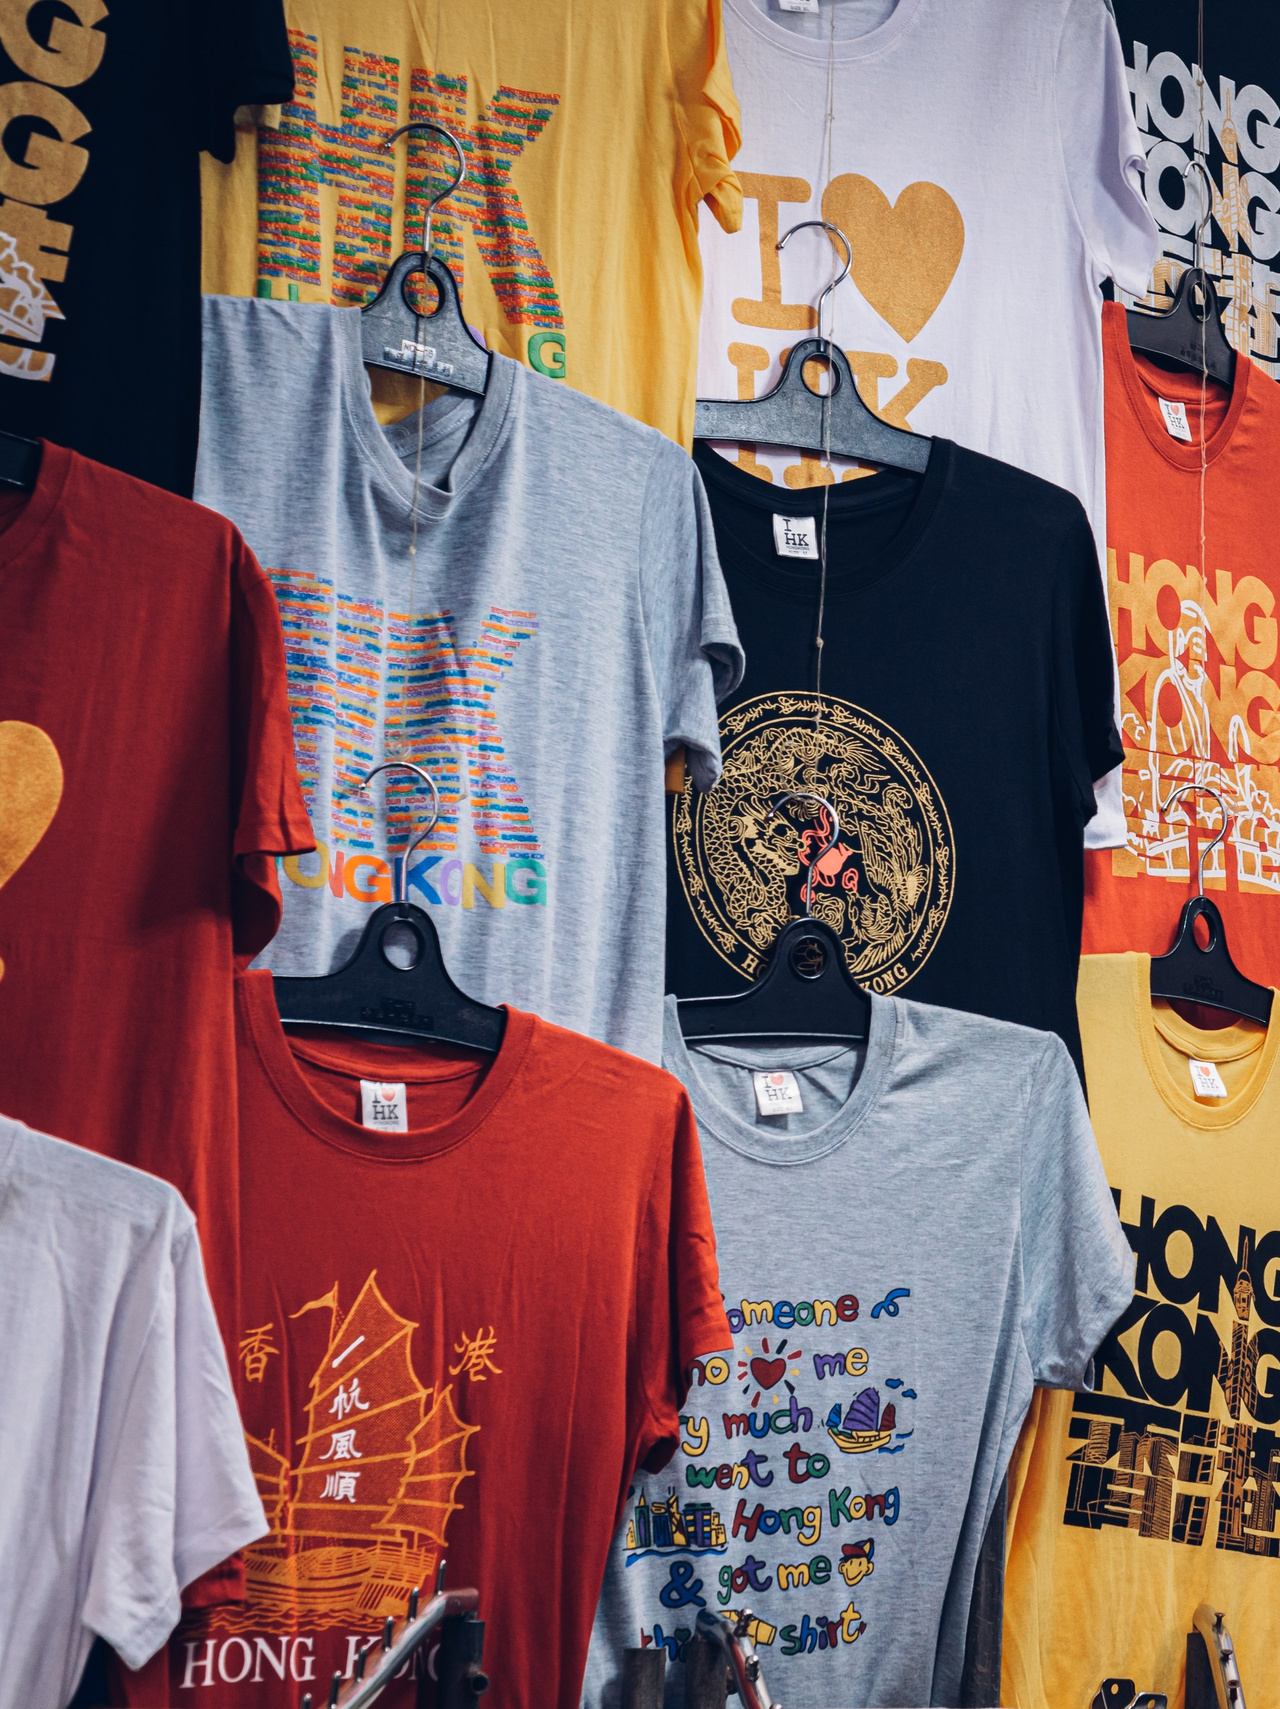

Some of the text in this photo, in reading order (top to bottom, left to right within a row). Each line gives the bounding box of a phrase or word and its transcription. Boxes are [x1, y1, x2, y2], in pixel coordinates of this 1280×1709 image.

[731, 170, 812, 331] I
[783, 518, 792, 532] I
[784, 532, 809, 547] HK
[1107, 548, 1279, 670] HONG
[276, 841, 548, 908] ONGKONG
[761, 1075, 772, 1089] I
[765, 1087, 793, 1101] HK
[1198, 1076, 1220, 1089] HK
[372, 1104, 399, 1120] HK
[722, 1294, 860, 1334] omeone
[239, 1323, 279, 1382] 香
[449, 1326, 502, 1380] 港
[813, 1347, 869, 1381] me
[722, 1395, 814, 1440] much
[686, 1442, 831, 1490] went to
[732, 1486, 900, 1546] Hong Kong
[659, 1555, 832, 1609] & got me
[779, 1601, 862, 1656] shirt
[179, 1636, 316, 1689] HONG
